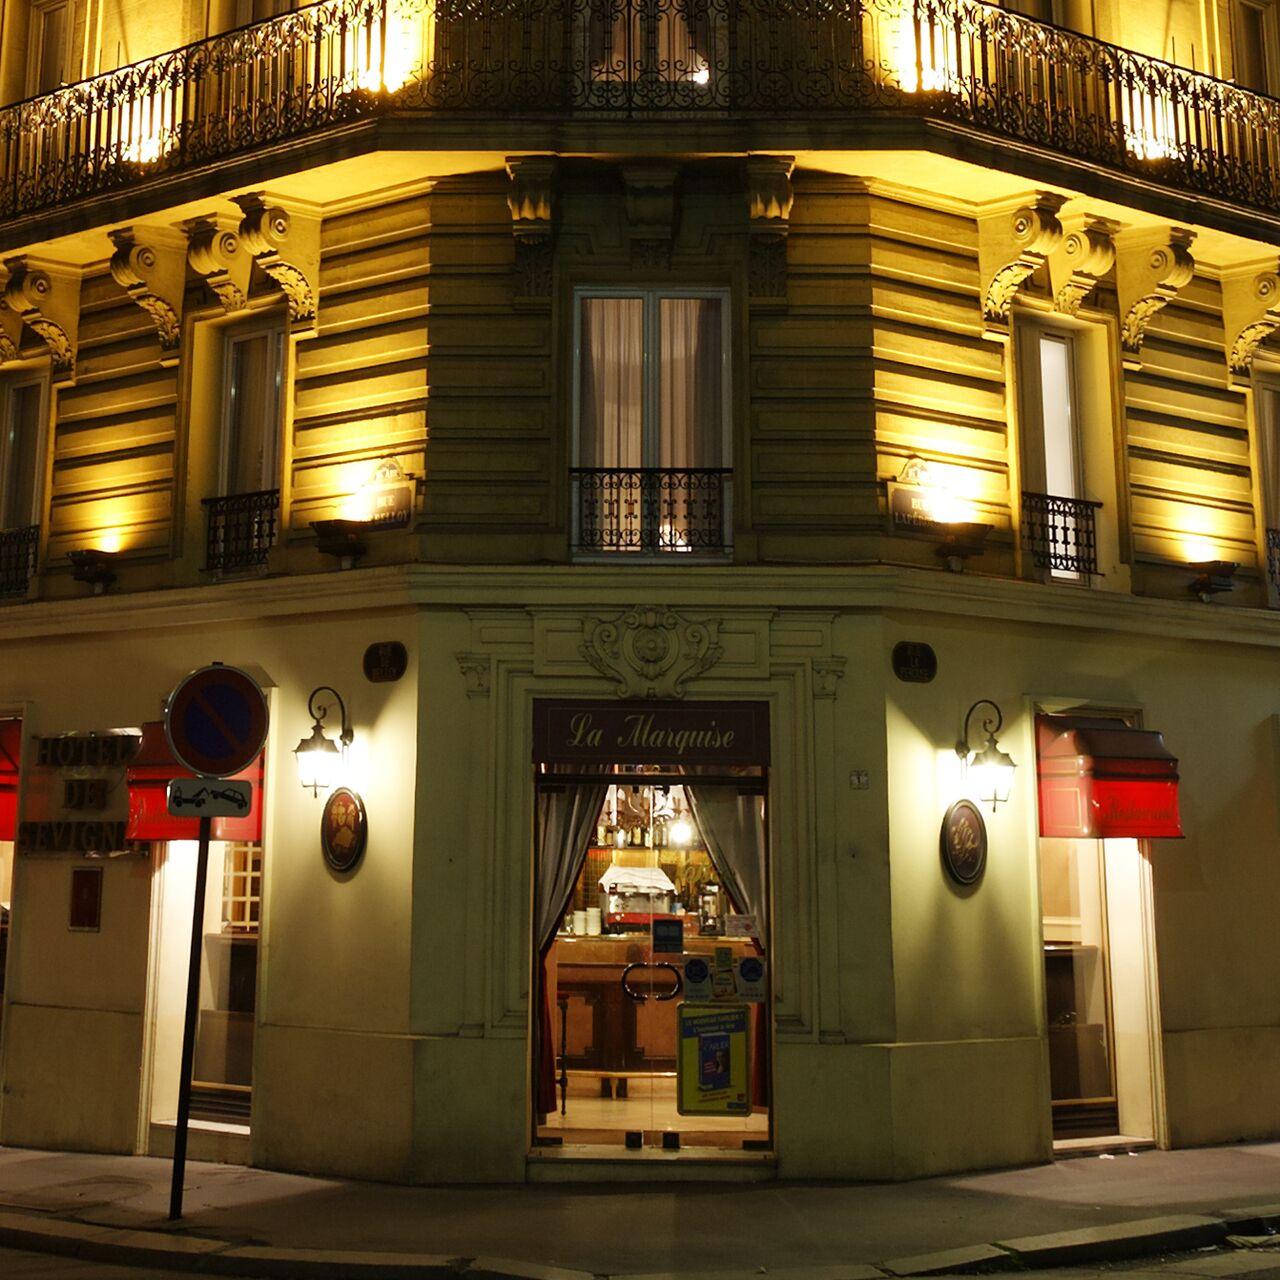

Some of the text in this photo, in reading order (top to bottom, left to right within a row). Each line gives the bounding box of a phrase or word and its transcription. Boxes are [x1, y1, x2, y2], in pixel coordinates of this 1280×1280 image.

[567, 713, 735, 755] La Marquise
[32, 735, 136, 767] HOTEL
[63, 779, 108, 810] DE
[18, 821, 149, 852] SEVIGN
